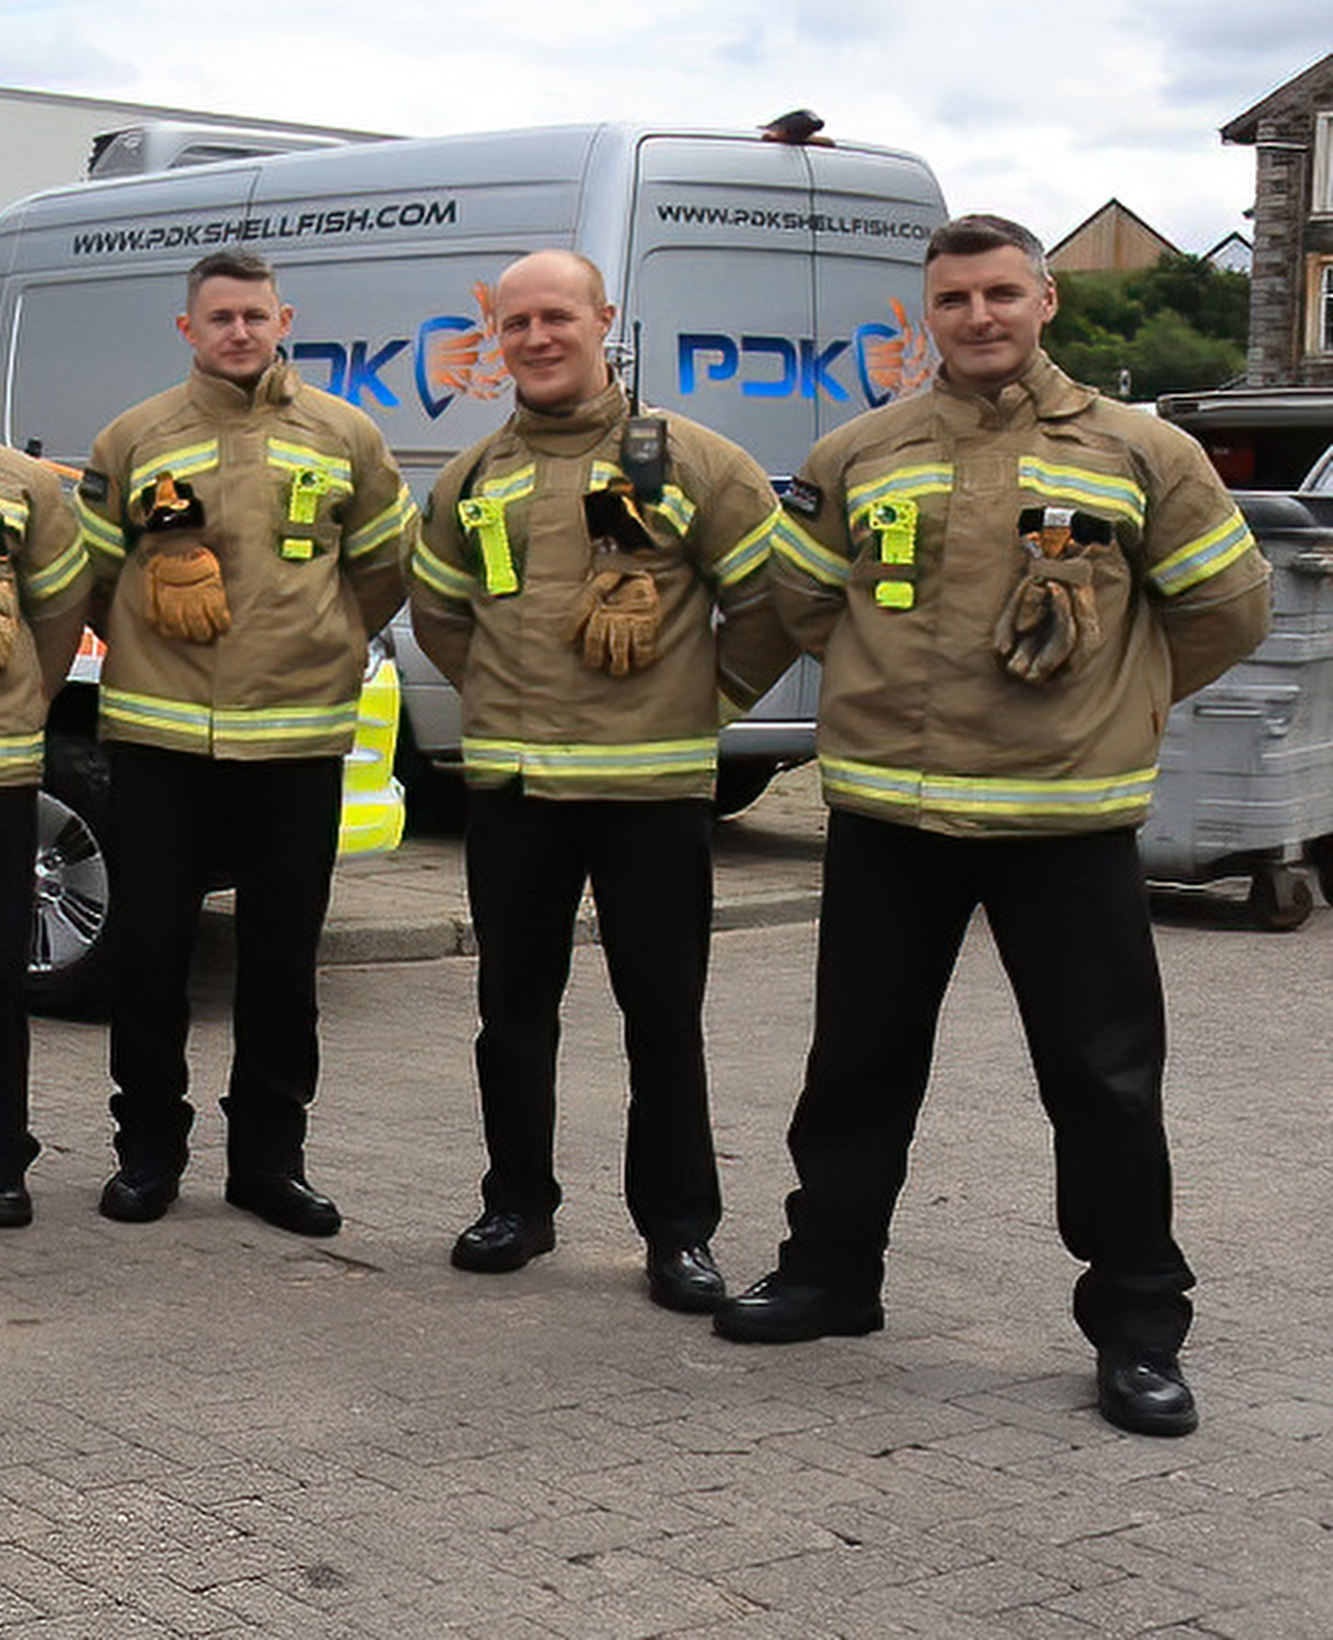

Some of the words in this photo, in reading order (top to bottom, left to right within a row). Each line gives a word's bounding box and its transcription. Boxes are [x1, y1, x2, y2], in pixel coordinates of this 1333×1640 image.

[73, 200, 457, 254] WWW.PDKSHELLFISH.COM
[657, 205, 931, 240] WWW.PDKSHELLFISH.CO
[276, 340, 411, 407] DK
[678, 333, 852, 401] PDK
